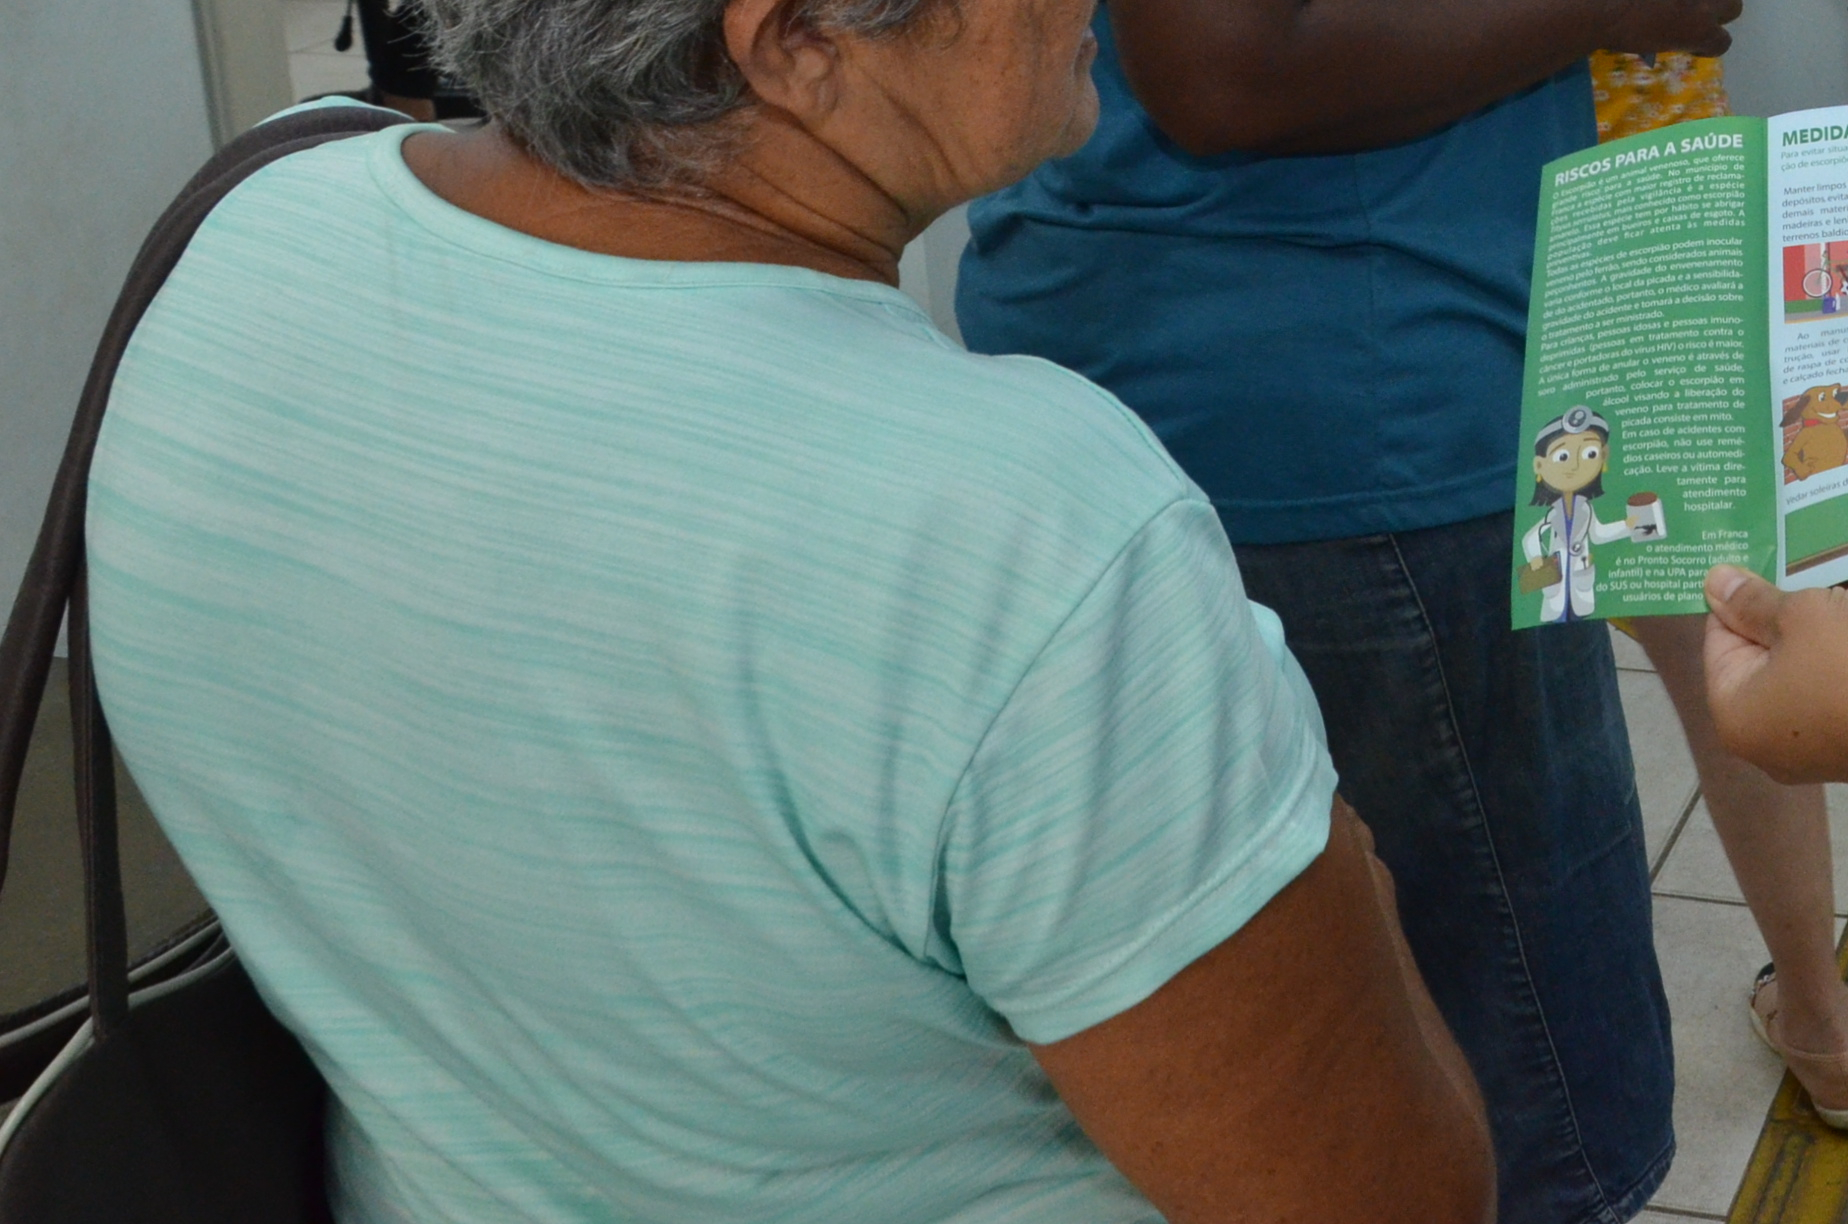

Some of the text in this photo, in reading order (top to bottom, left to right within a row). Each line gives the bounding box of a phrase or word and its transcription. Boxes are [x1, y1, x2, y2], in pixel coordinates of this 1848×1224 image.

[1781, 151, 1799, 159] Para
[1801, 147, 1825, 156] evitar
[1554, 132, 1744, 187] RISCOS PARA A SAÚDE
[1781, 162, 1796, 172] ção
[1798, 160, 1809, 169] de
[1784, 186, 1815, 196] Manter
[1817, 182, 1847, 192] limpos
[1782, 208, 1814, 219] demais
[1782, 219, 1824, 230] madeiras
[1782, 232, 1819, 242] terrenos
[1797, 332, 1810, 341] Ao
[1784, 341, 1825, 353] materiais
[1828, 338, 1840, 347] de
[1784, 353, 1814, 363] trução,
[1821, 349, 1840, 357] usar
[1783, 366, 1794, 374] de
[1797, 362, 1822, 371] raspa
[1824, 359, 1836, 367] de
[1789, 371, 1824, 383] calçado
[1615, 400, 1745, 416] veneno para tratamento de
[1621, 417, 1652, 429] picada
[1653, 414, 1691, 424] consiste
[1709, 413, 1734, 421] mito.
[1621, 425, 1745, 440] Em caso de acidentes com
[1622, 437, 1745, 452] escorpião, não use remé-
[1623, 449, 1745, 464] dios caseiros ou automedi-
[1624, 465, 1653, 476] cação.
[1656, 464, 1679, 473] Leve
[1690, 462, 1720, 472] vítima
[1723, 462, 1746, 471] dire-
[1677, 476, 1746, 486] tamente para
[1682, 488, 1747, 499] atendimento
[1785, 493, 1808, 505] Vedar
[1810, 482, 1841, 496] soleiras
[1684, 500, 1735, 512] hospitalar.
[1701, 530, 1748, 540] Em Franca
[1654, 543, 1714, 553] atendimento
[1715, 541, 1749, 551] médico
[1615, 555, 1706, 566] é no Pronto Socorro
